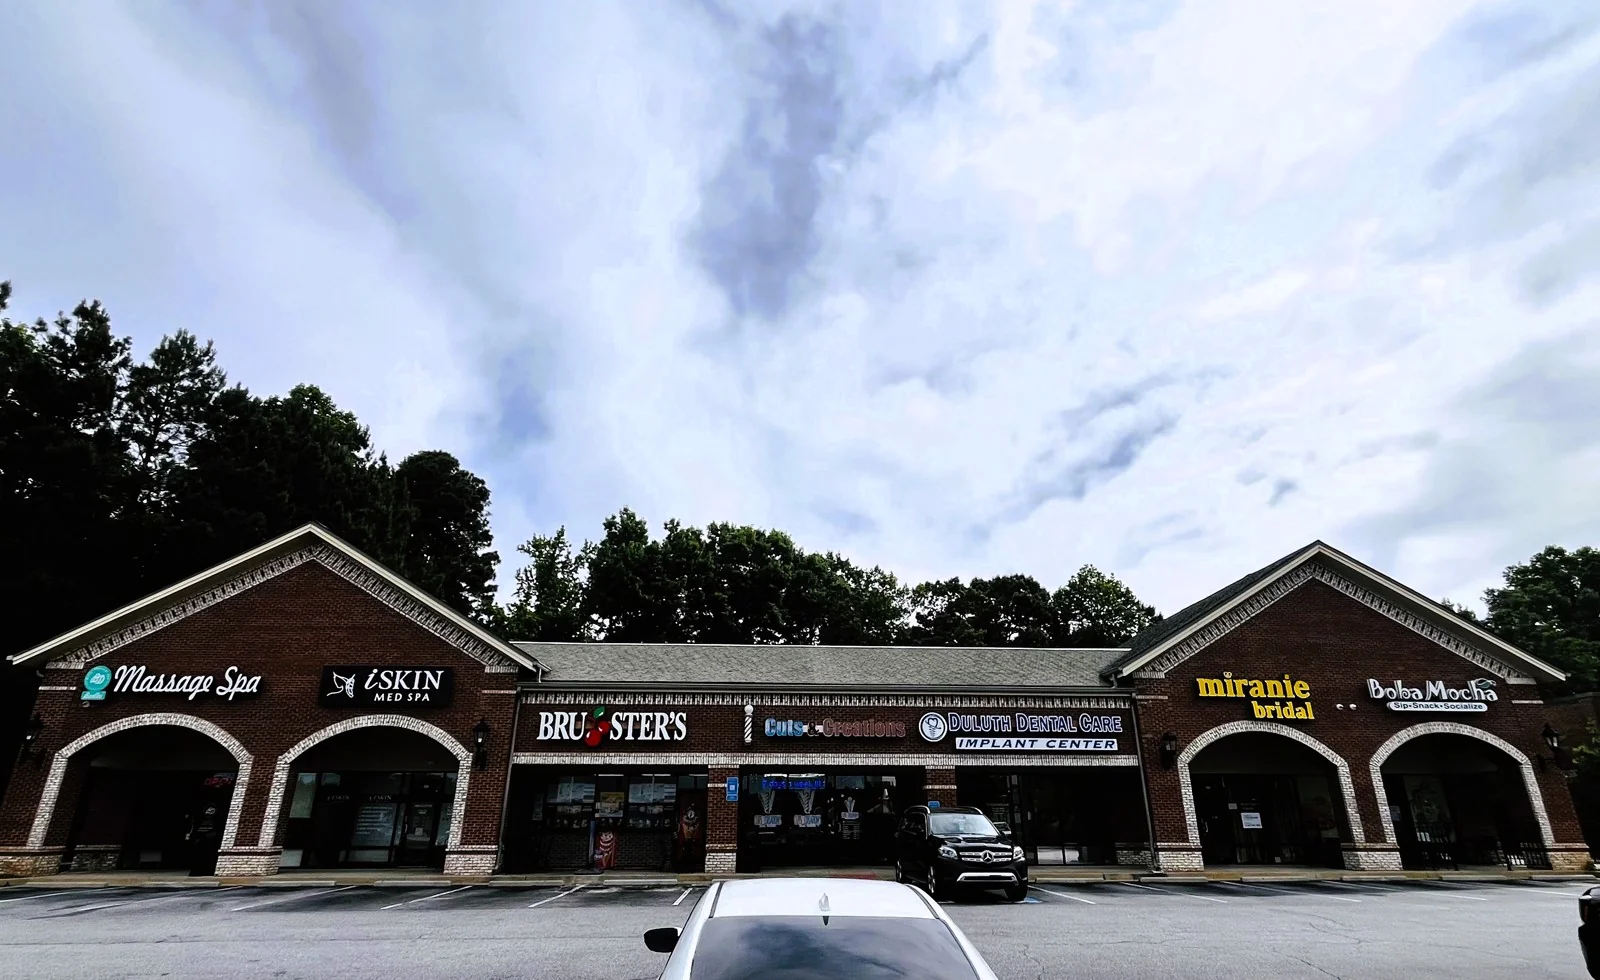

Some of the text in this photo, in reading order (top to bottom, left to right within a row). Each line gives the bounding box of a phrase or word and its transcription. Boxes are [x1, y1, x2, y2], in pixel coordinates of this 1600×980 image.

[113, 665, 262, 700] Massage Spa
[364, 668, 444, 690] iSKIN
[1196, 671, 1310, 699] miranie
[1366, 678, 1498, 701] Boba Mocha
[374, 693, 430, 702] MED SPA
[1251, 701, 1315, 719] bridal
[536, 711, 687, 741] BRUSTER'S
[765, 718, 906, 738] Cuts & Creations
[948, 712, 1123, 733] DULUTH DENTAL CARE
[958, 738, 1116, 750] IMPLANT CENTER
